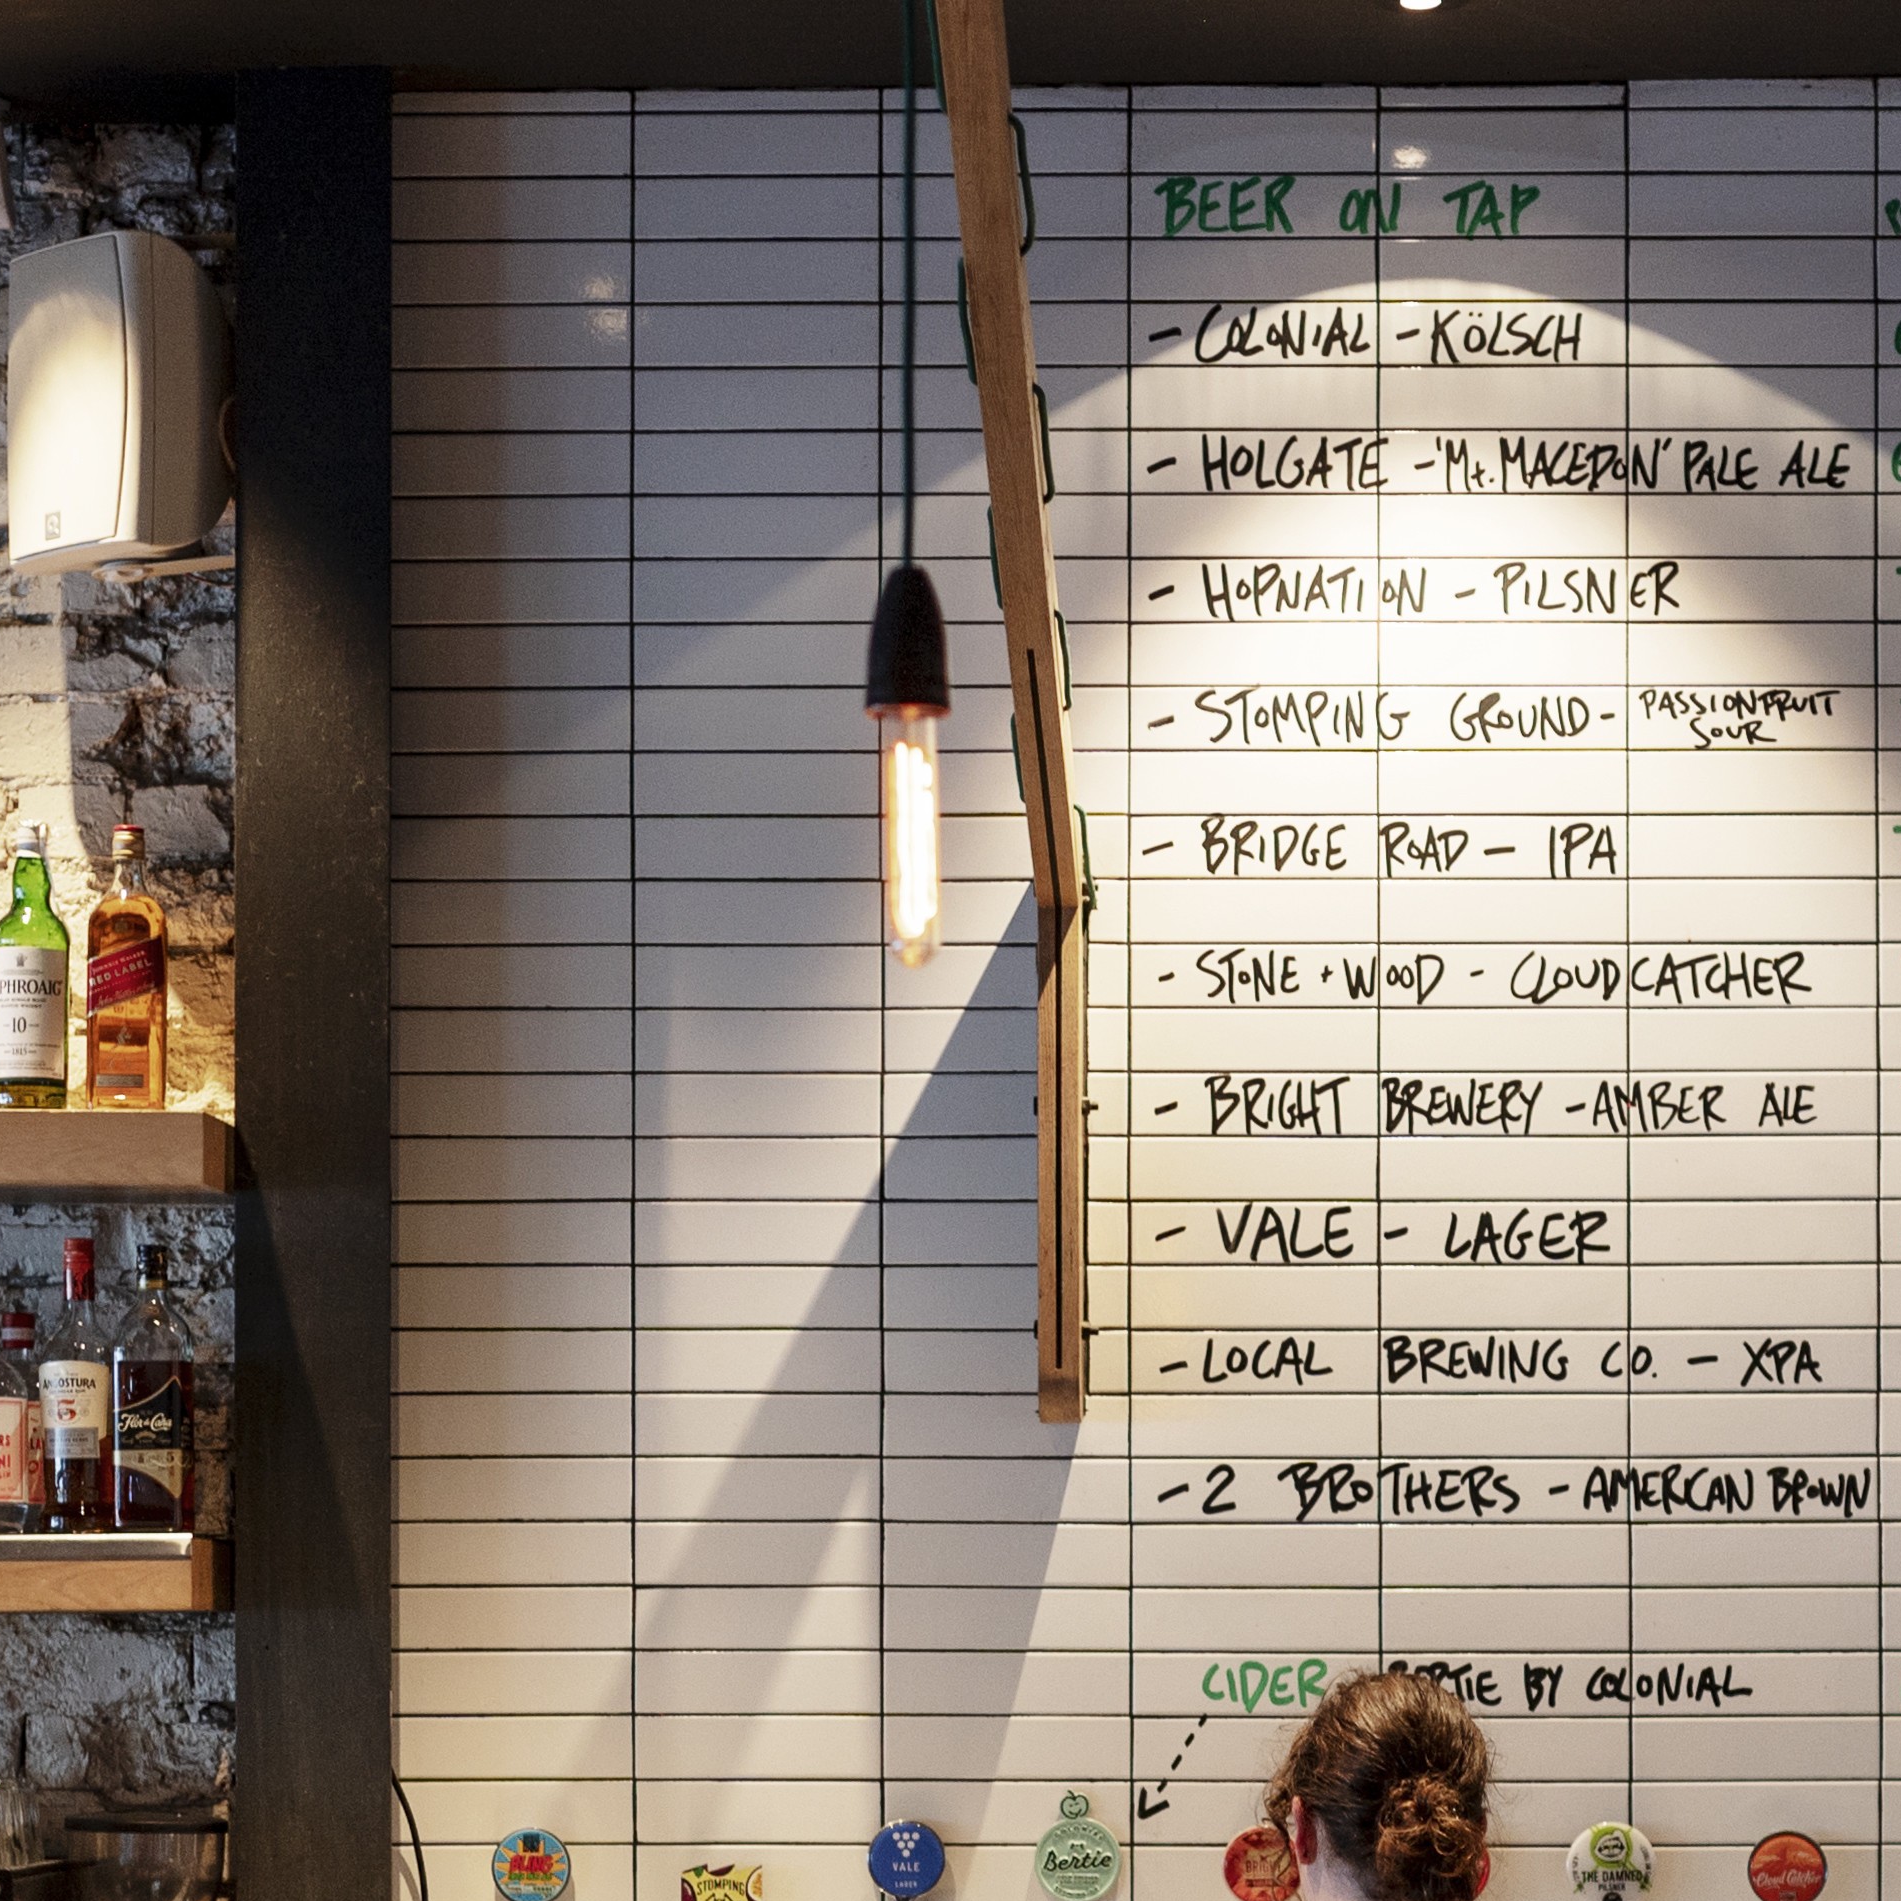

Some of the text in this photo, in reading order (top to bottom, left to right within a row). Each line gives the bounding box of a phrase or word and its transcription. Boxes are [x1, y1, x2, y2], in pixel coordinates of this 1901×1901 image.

[1154, 175, 1540, 239] BEER ON TAP
[1195, 304, 1582, 363] COLONIAL KÖLSCH
[1202, 436, 1388, 491] HOLGATE
[1685, 441, 1757, 492] PALE
[1779, 441, 1850, 489] ALE
[1202, 561, 1679, 618] HOPNATION PILSNER
[1196, 686, 1840, 746] STOMPING GROUND PASSIONFRUIT
[1690, 717, 1777, 749] SOUR
[1202, 815, 1617, 877] BRIDGE ROAD IPA
[89, 958, 153, 987] RED LABEL
[1196, 948, 1299, 1003] STONE
[1343, 954, 1444, 1005] WOOD
[11, 1017, 27, 1033] 10
[1205, 1075, 1816, 1137] BRIGHT BREWERY AMBER ALE
[1215, 1204, 1612, 1262] VALE LAGER
[1202, 1337, 1823, 1387] LOCAL BREWING CO. XPA
[56, 1399, 77, 1421] 5
[1202, 1466, 1237, 1514] 2
[1279, 1463, 1520, 1522] BROTHERS
[1202, 1658, 1752, 1713] CIDER BY COLONIAL
[697, 1879, 745, 1896] STOMPING
[892, 1861, 921, 1872] VALE
[1043, 1849, 1113, 1872] Bertie
[1581, 1871, 1643, 1883] THE DAMNED
[1598, 1883, 1626, 1891] PILSNER
